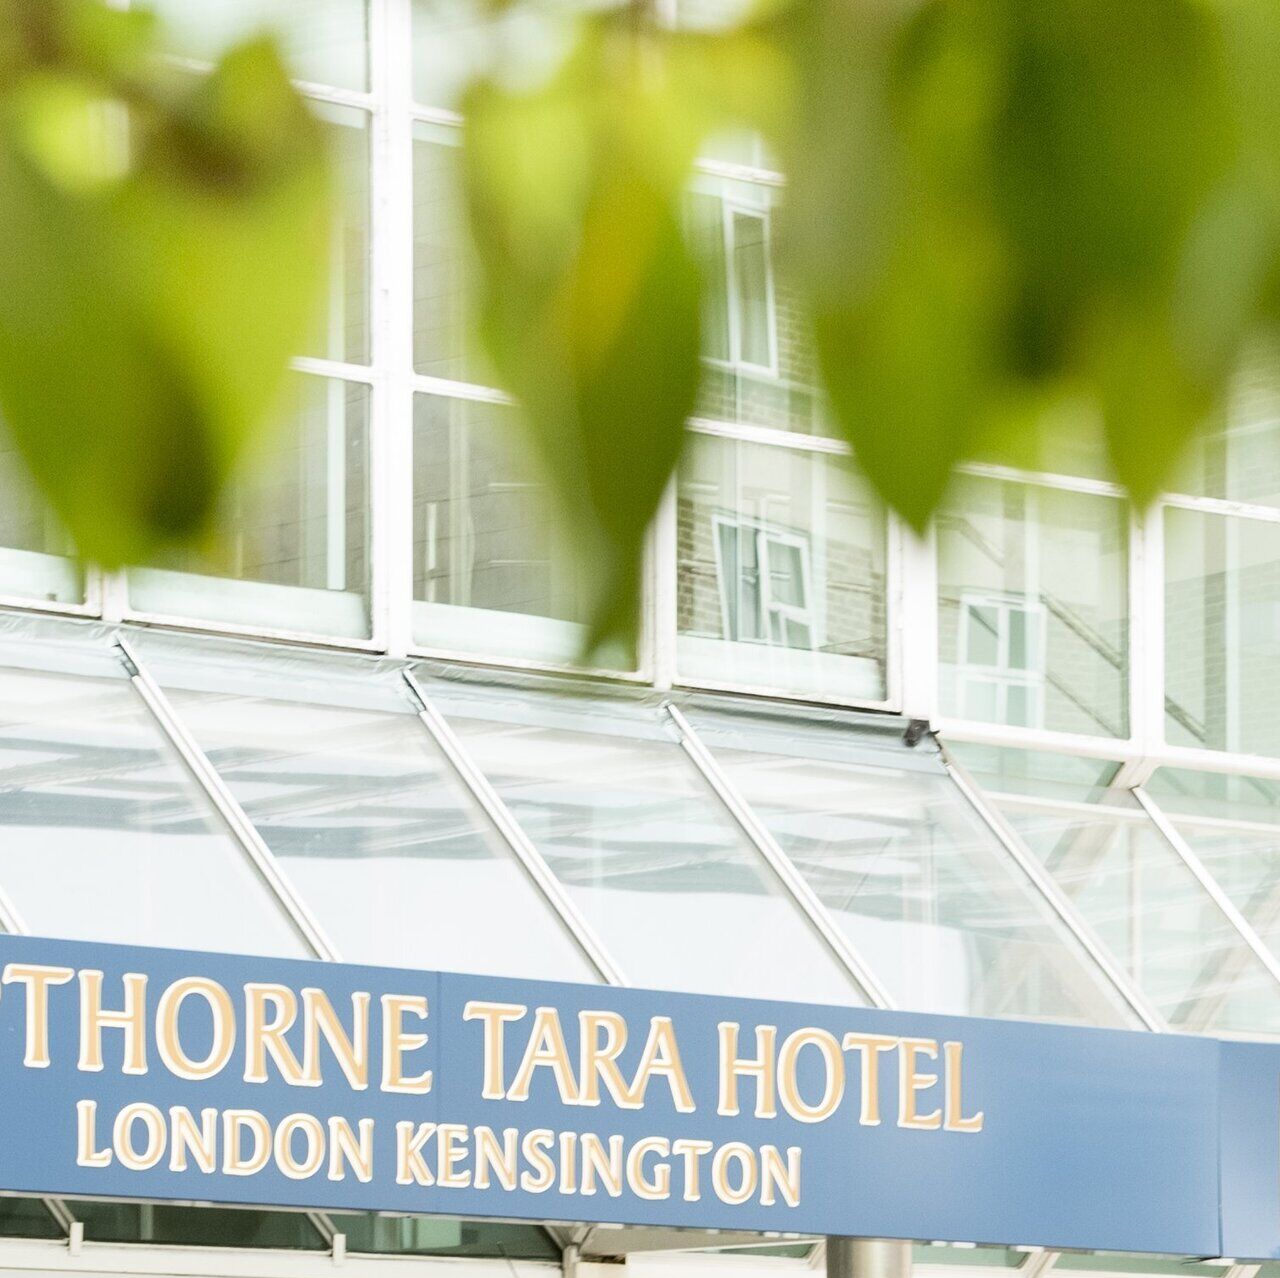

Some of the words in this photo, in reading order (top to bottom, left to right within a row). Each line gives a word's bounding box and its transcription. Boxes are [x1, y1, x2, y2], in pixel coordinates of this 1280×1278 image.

[463, 1000, 696, 1114] TARA
[716, 1021, 984, 1133] HOTEL
[77, 1099, 375, 1182] LONDON
[395, 1120, 802, 1208] KENSINGTON
